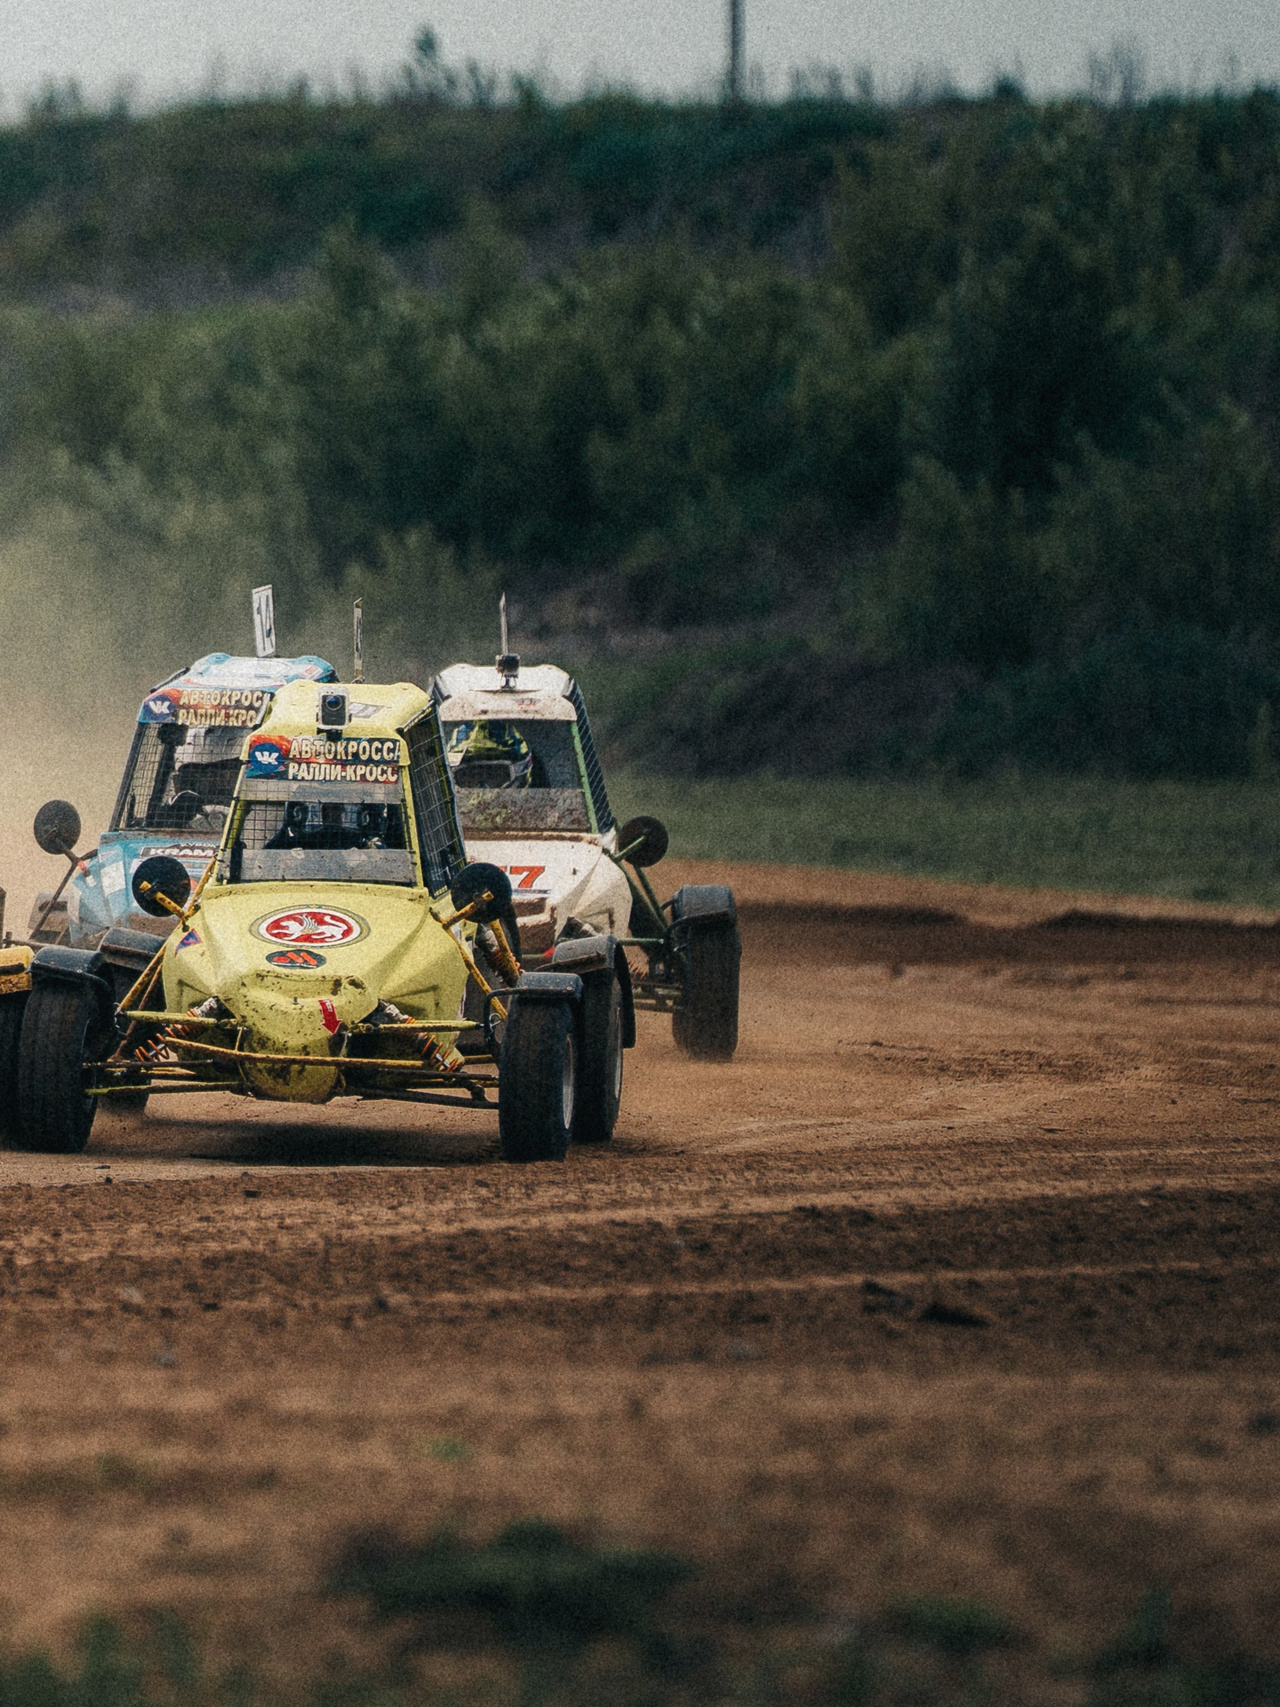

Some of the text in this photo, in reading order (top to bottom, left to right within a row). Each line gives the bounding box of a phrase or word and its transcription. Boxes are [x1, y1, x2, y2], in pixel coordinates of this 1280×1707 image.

[180, 690, 267, 708] АВТОКРОС
[178, 709, 258, 727] РАЛЛИ-КРО
[287, 762, 398, 782] РАЛЛИ-КРОСС
[149, 848, 220, 857] KRAM
